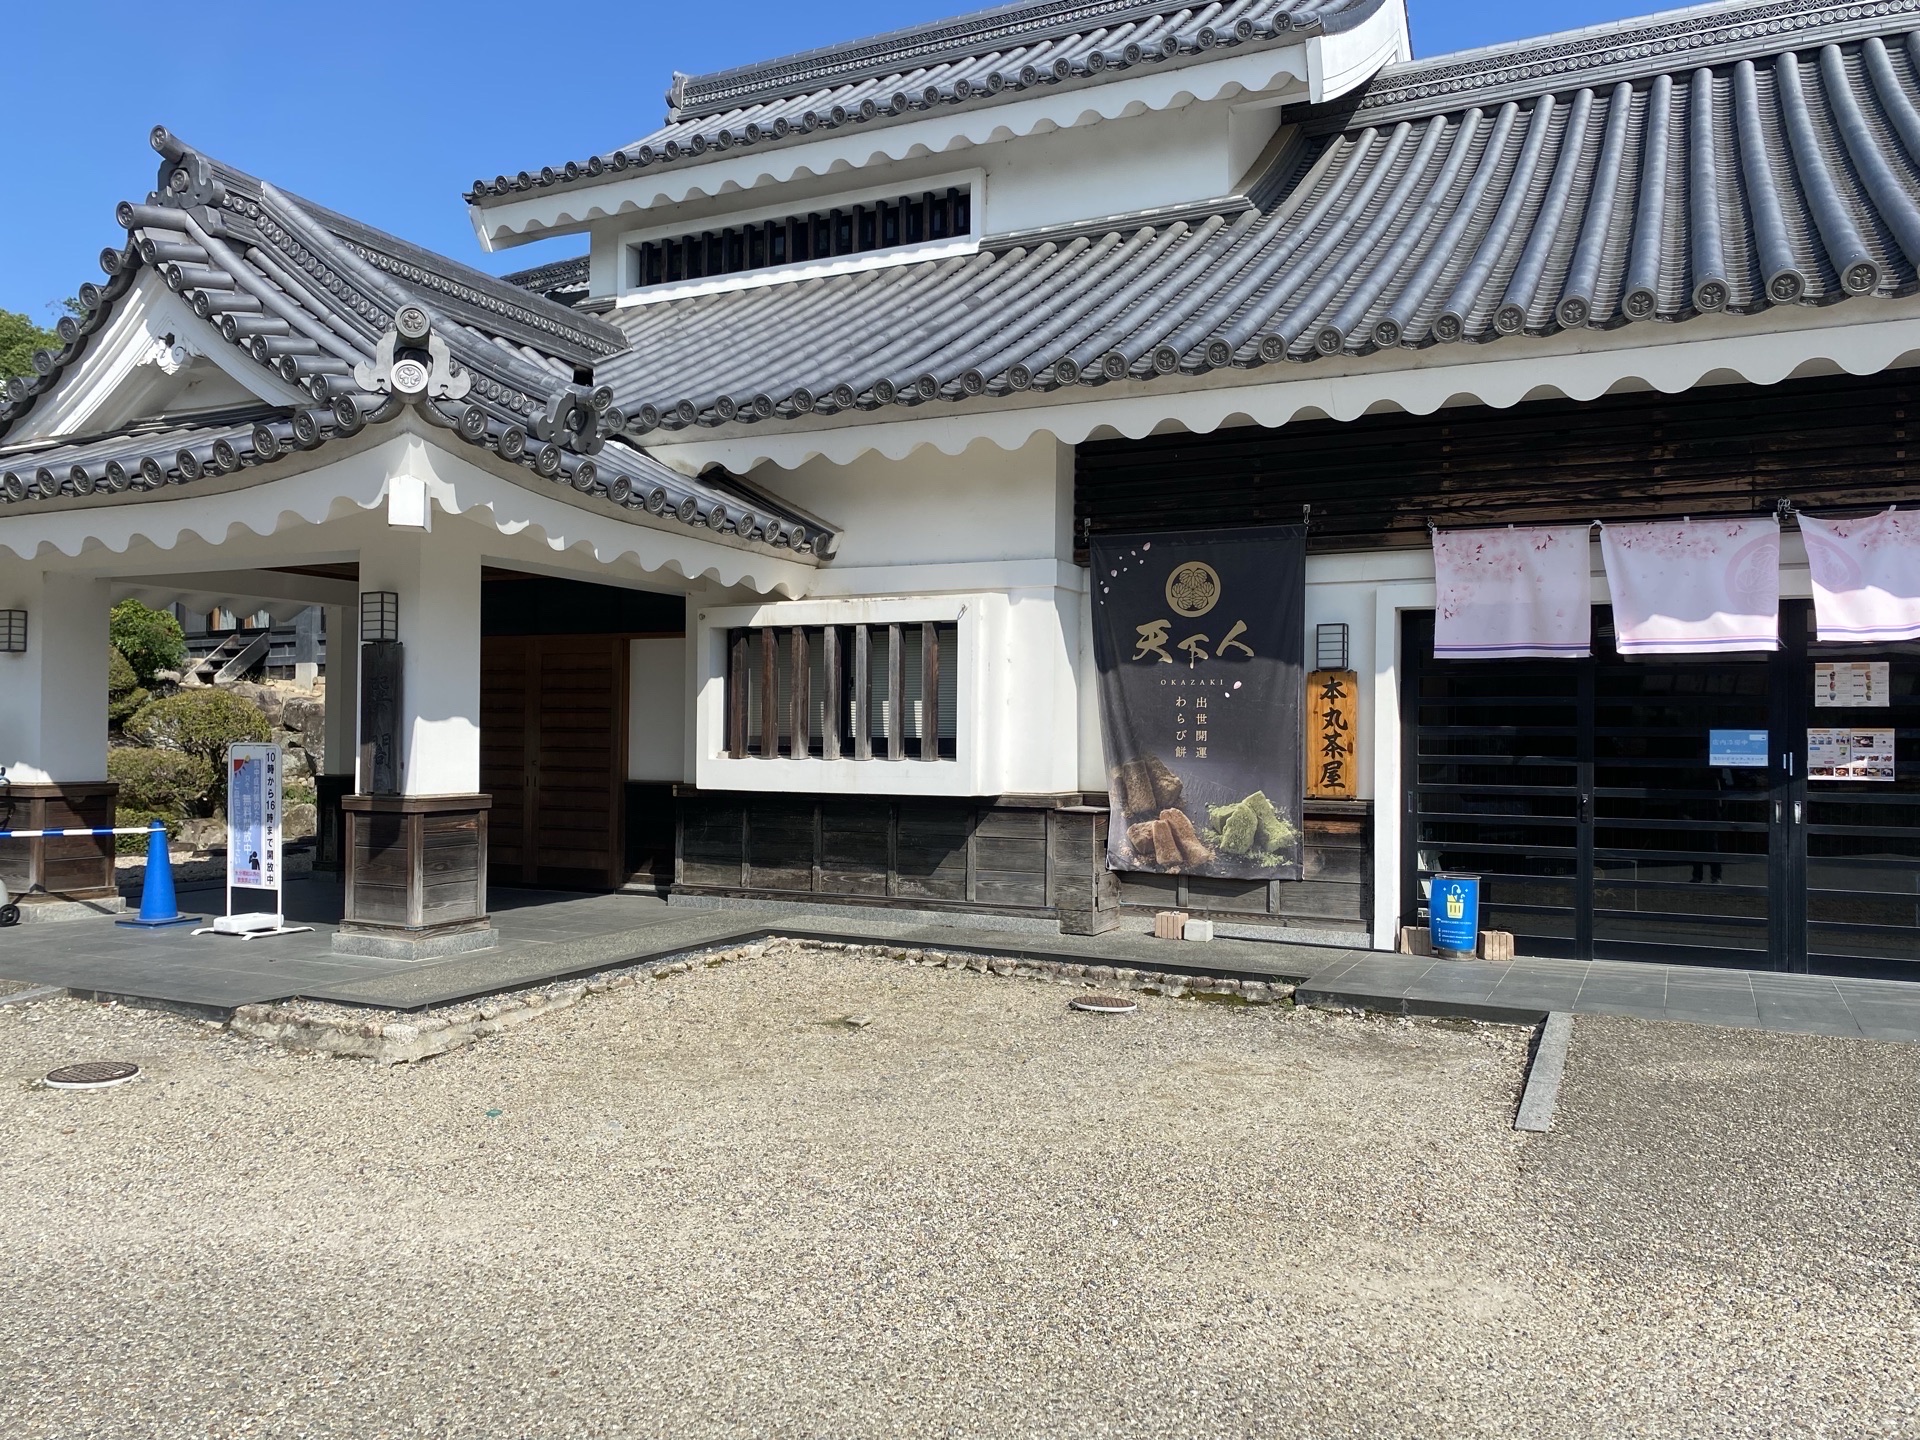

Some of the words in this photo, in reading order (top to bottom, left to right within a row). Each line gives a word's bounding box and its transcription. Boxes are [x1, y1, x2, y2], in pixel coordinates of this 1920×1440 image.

[1132, 619, 1255, 670] 天下人
[1174, 696, 1187, 758] わらび餅
[1196, 696, 1208, 759] 出世開運
[1319, 676, 1349, 788] 本丸茶屋
[266, 752, 276, 884] 10時から16時まで開放中
